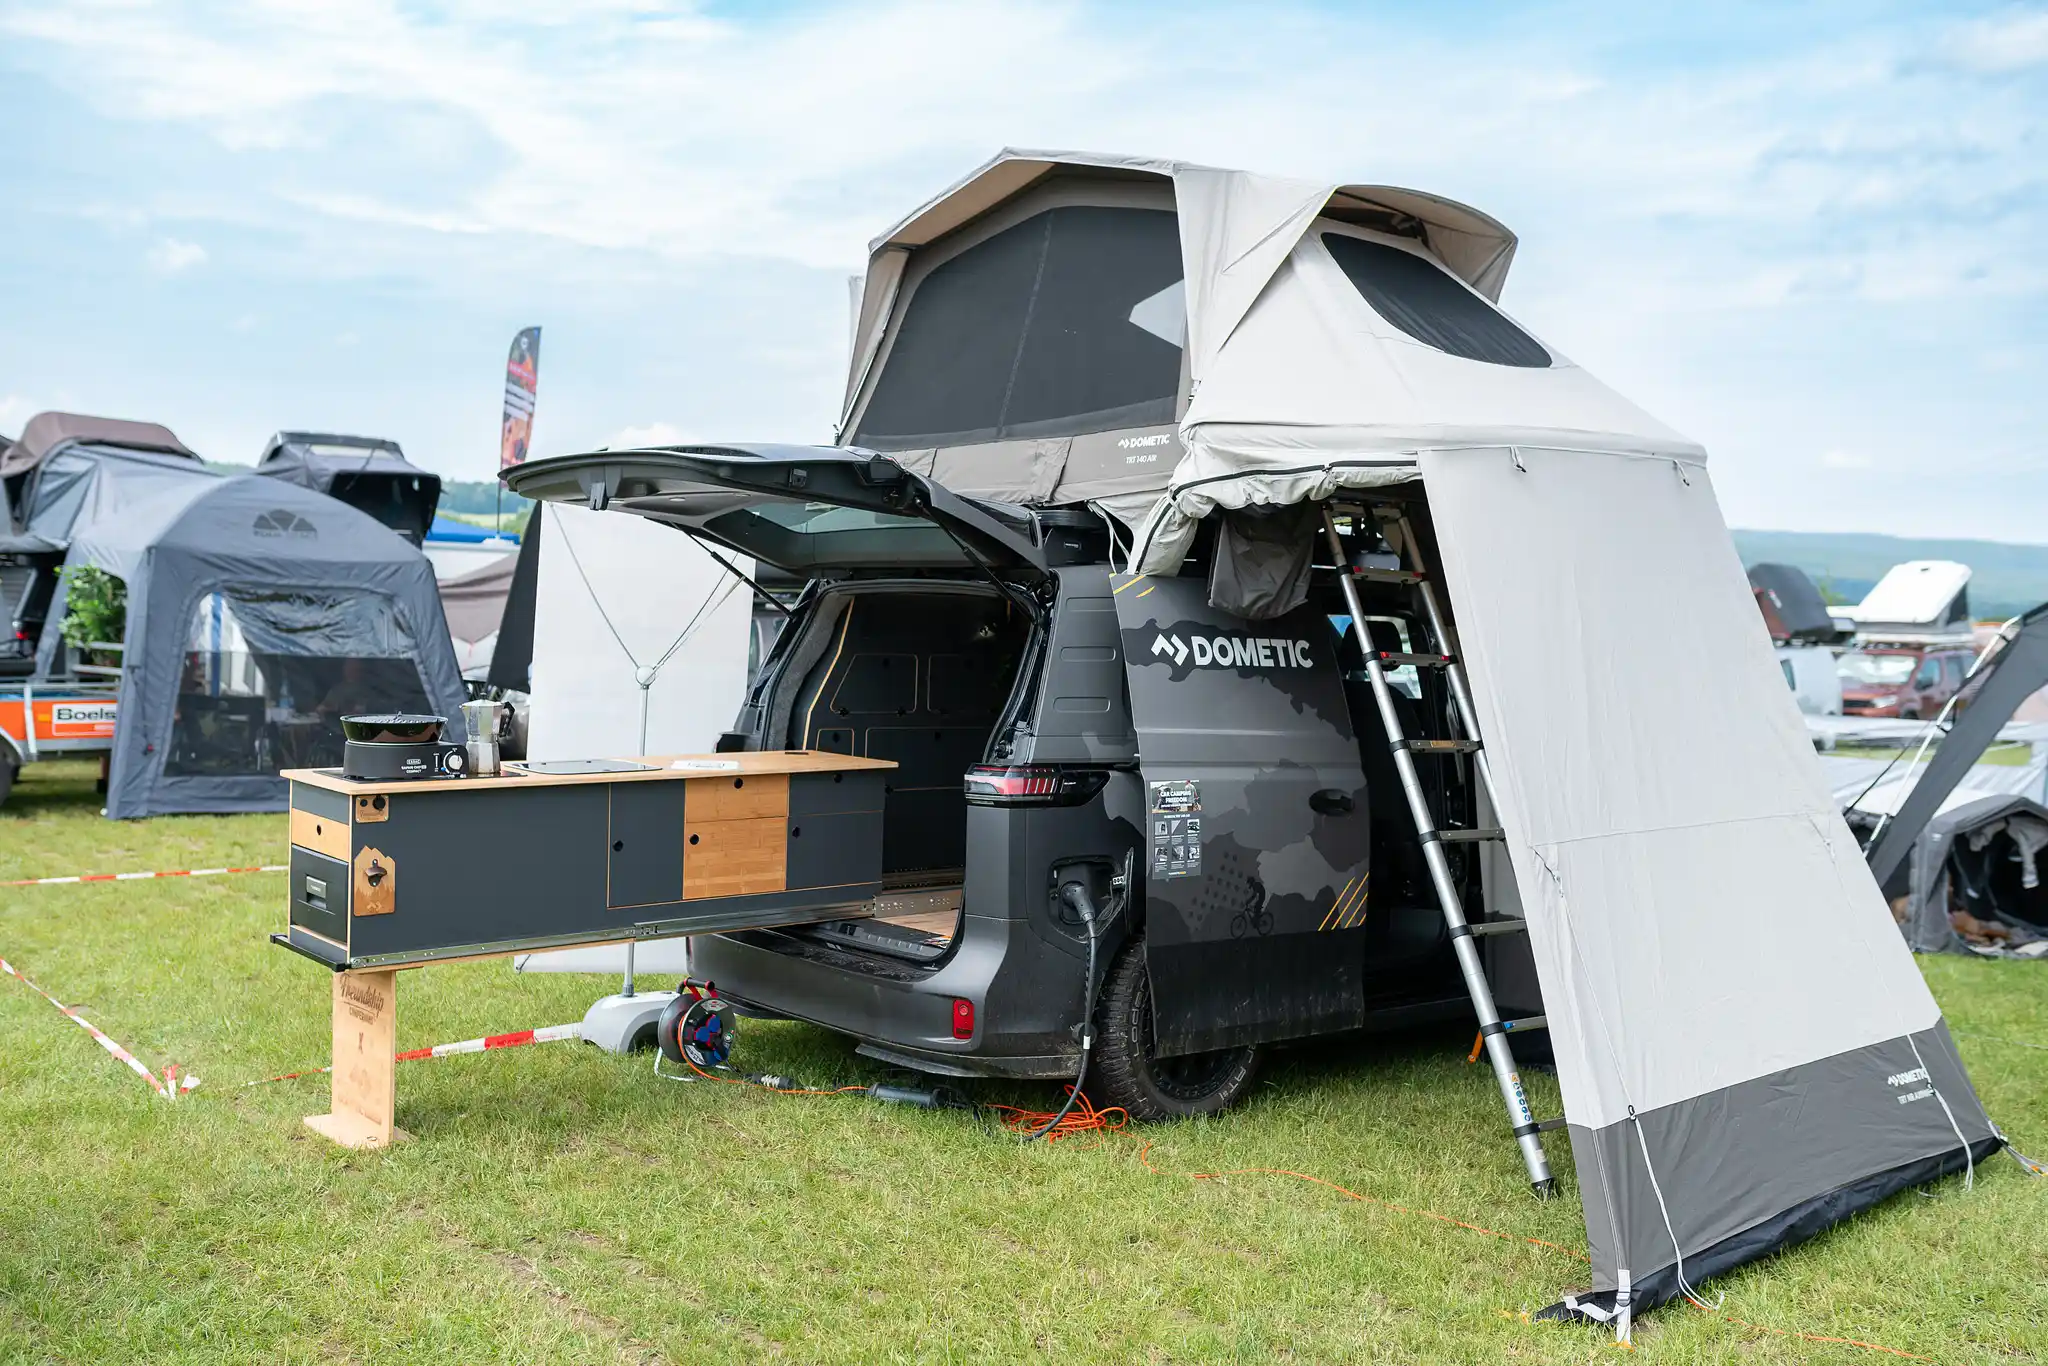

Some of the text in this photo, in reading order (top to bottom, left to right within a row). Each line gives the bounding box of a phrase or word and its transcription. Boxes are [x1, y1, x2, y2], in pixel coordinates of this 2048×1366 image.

[1130, 434, 1170, 448] DOMETIC
[1191, 635, 1314, 668] DOMETIC
[57, 708, 116, 720] Boels
[1896, 1068, 1928, 1086] DOMETIC
